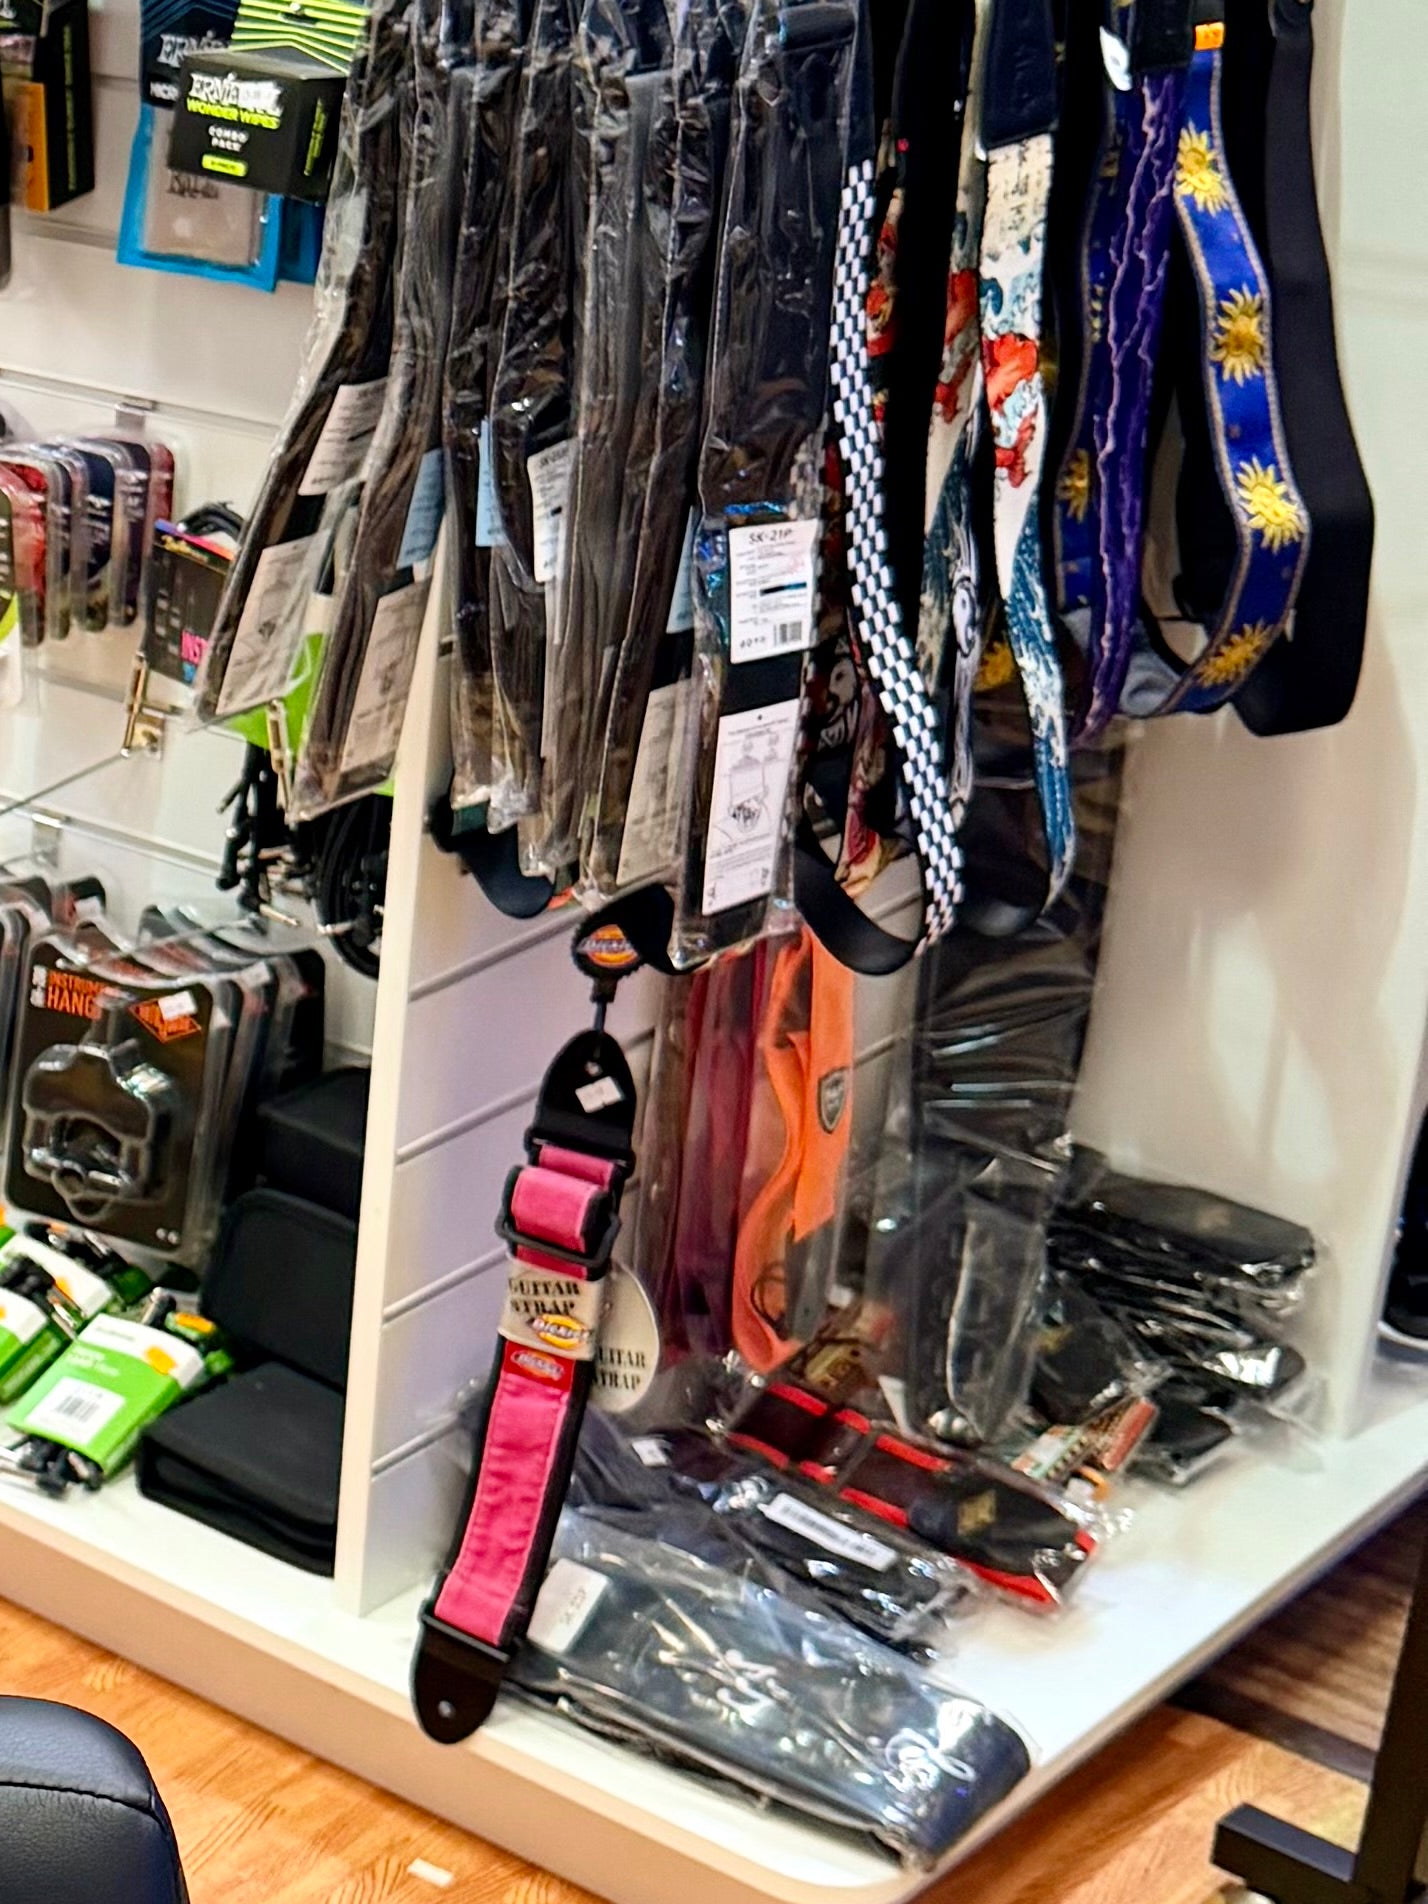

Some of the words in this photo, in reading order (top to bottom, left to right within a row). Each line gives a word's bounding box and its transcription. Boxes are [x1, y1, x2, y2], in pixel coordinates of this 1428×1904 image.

[186, 97, 239, 122] WONDER
[747, 525, 797, 546] SK-21P
[49, 972, 107, 997] INSTRUM
[47, 988, 99, 1020] HANG
[508, 1278, 581, 1296] GUITAR
[510, 1299, 576, 1317] STRAP
[597, 1346, 646, 1370] UITAR
